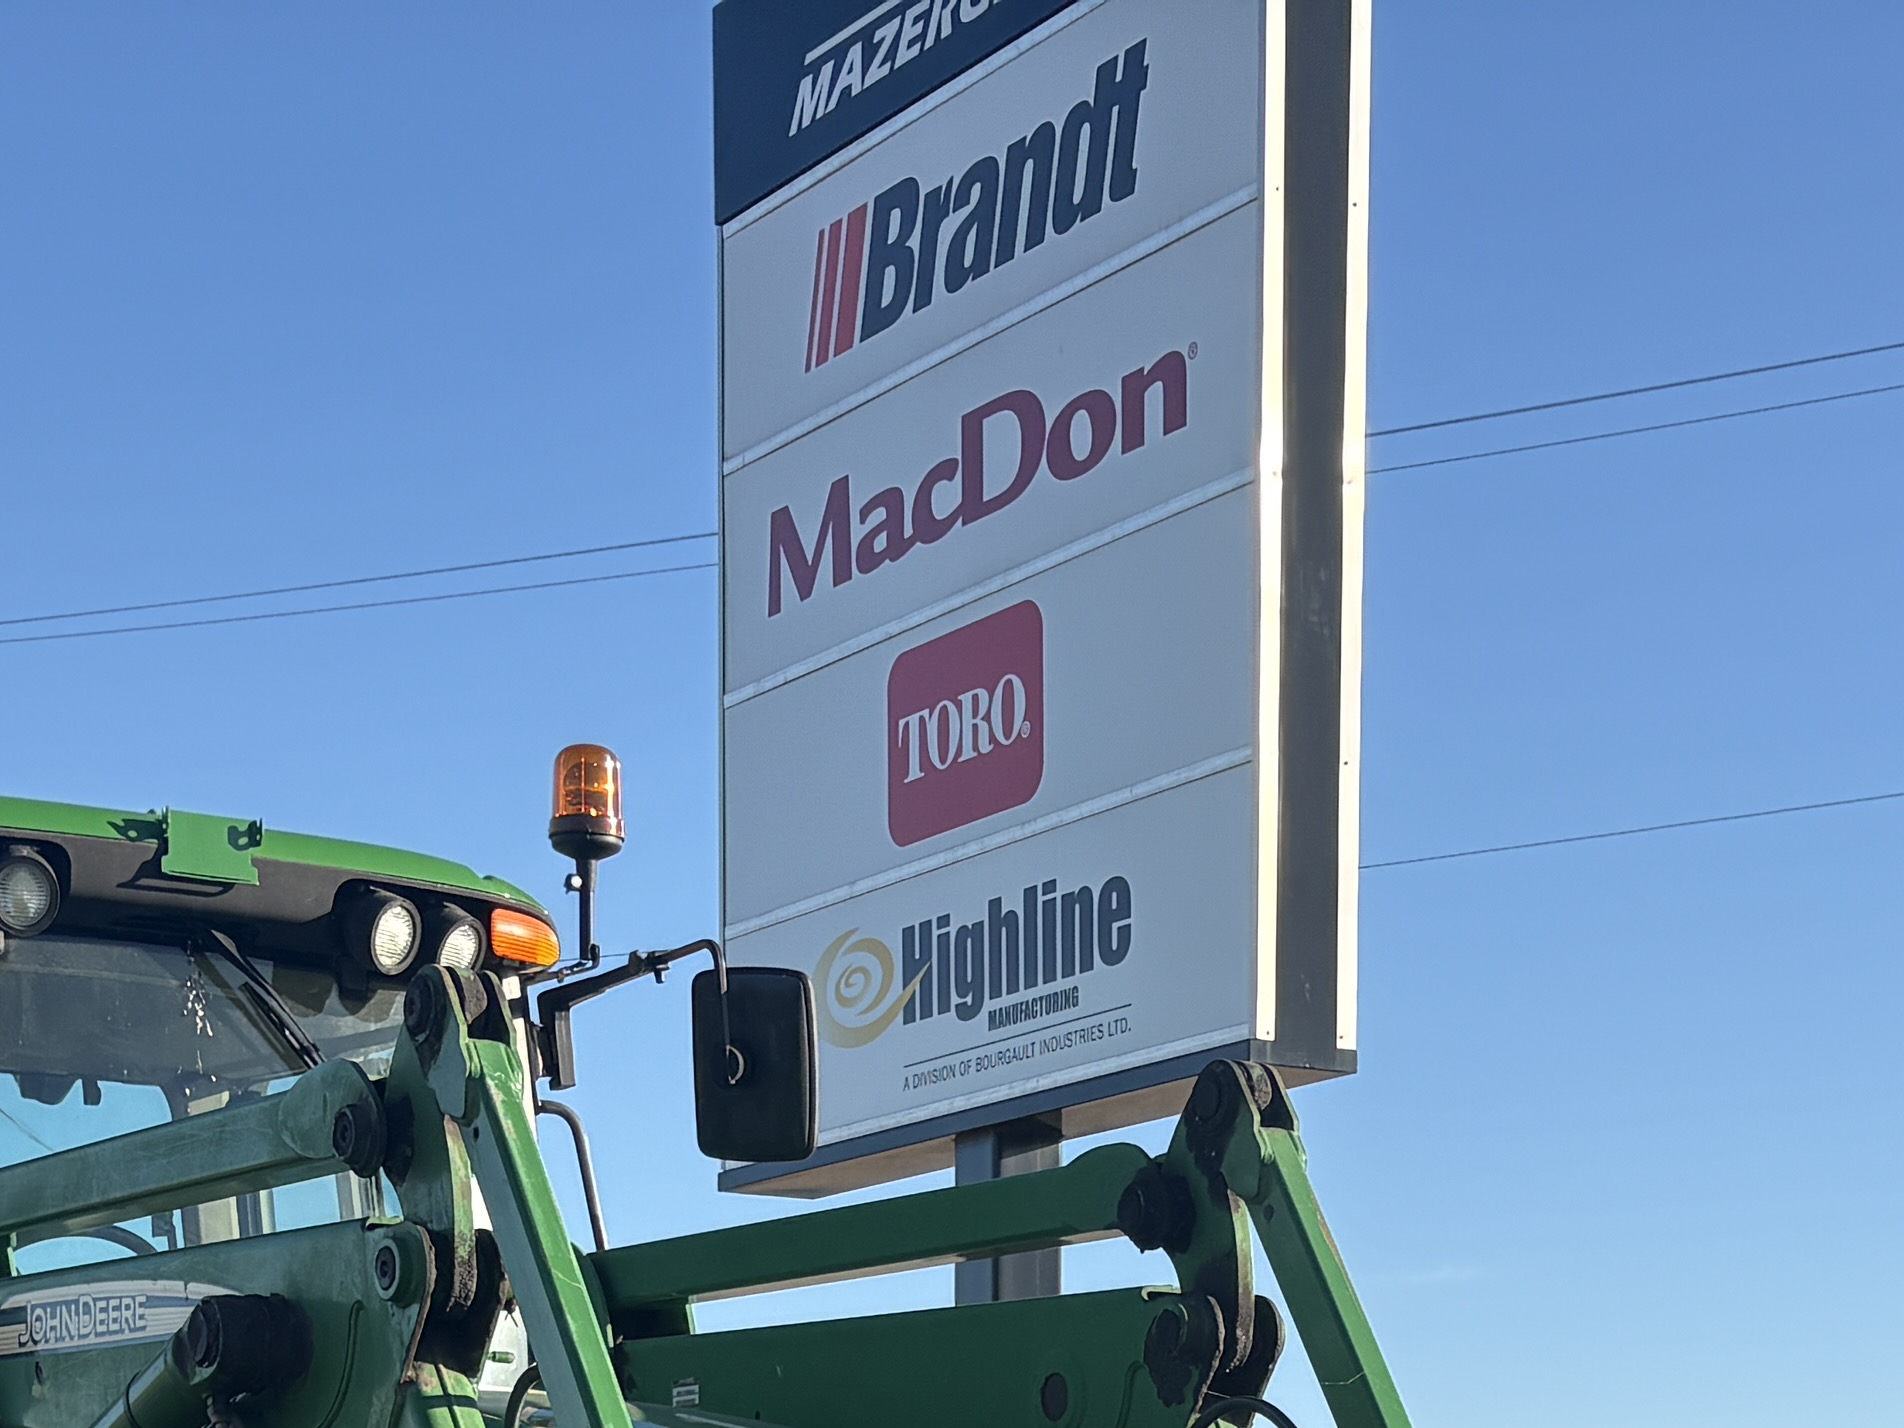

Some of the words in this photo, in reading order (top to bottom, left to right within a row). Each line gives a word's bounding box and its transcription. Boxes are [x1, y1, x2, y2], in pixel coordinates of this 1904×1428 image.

[859, 37, 1149, 344] Brandt
[767, 350, 1189, 618] MacDon
[901, 875, 1133, 1027] Highline
[902, 1076, 911, 1092] A
[912, 1064, 956, 1090] DIVISION
[959, 1058, 973, 1077] OF
[975, 1042, 1037, 1073] BOURGAULT
[1039, 1026, 1105, 1056] INDUSTRIES
[1107, 1017, 1132, 1038] LTD.
[987, 986, 1080, 1032] MANUFACTURING
[18, 1302, 77, 1347] JOHN
[77, 1293, 148, 1338] DEERE
